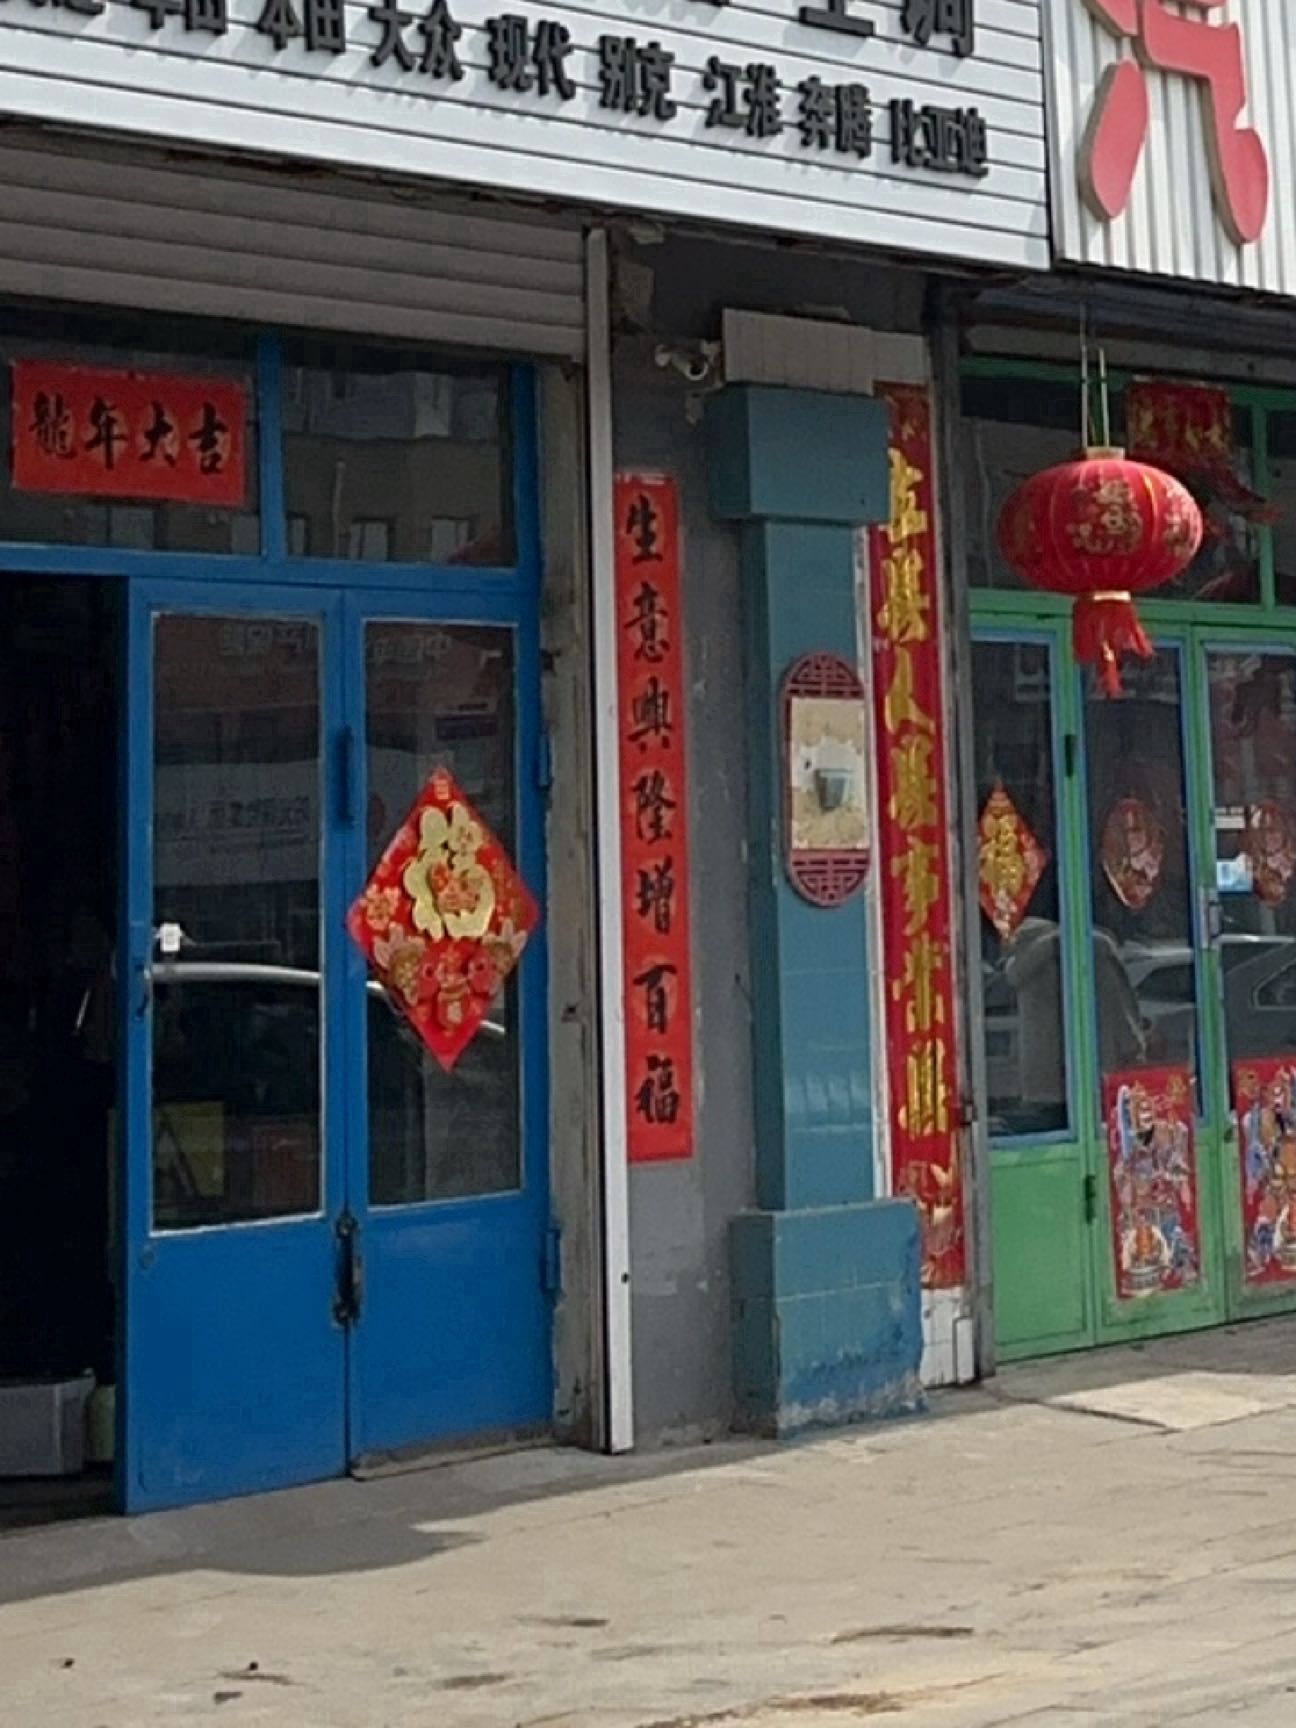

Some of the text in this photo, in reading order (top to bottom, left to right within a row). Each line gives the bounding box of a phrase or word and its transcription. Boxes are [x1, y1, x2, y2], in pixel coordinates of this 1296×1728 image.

[485, 14, 576, 101] 现代
[599, 35, 676, 120] 别克
[703, 56, 782, 139] 江淮
[798, 76, 872, 159] 奔腾
[890, 99, 988, 178] 比亚迪
